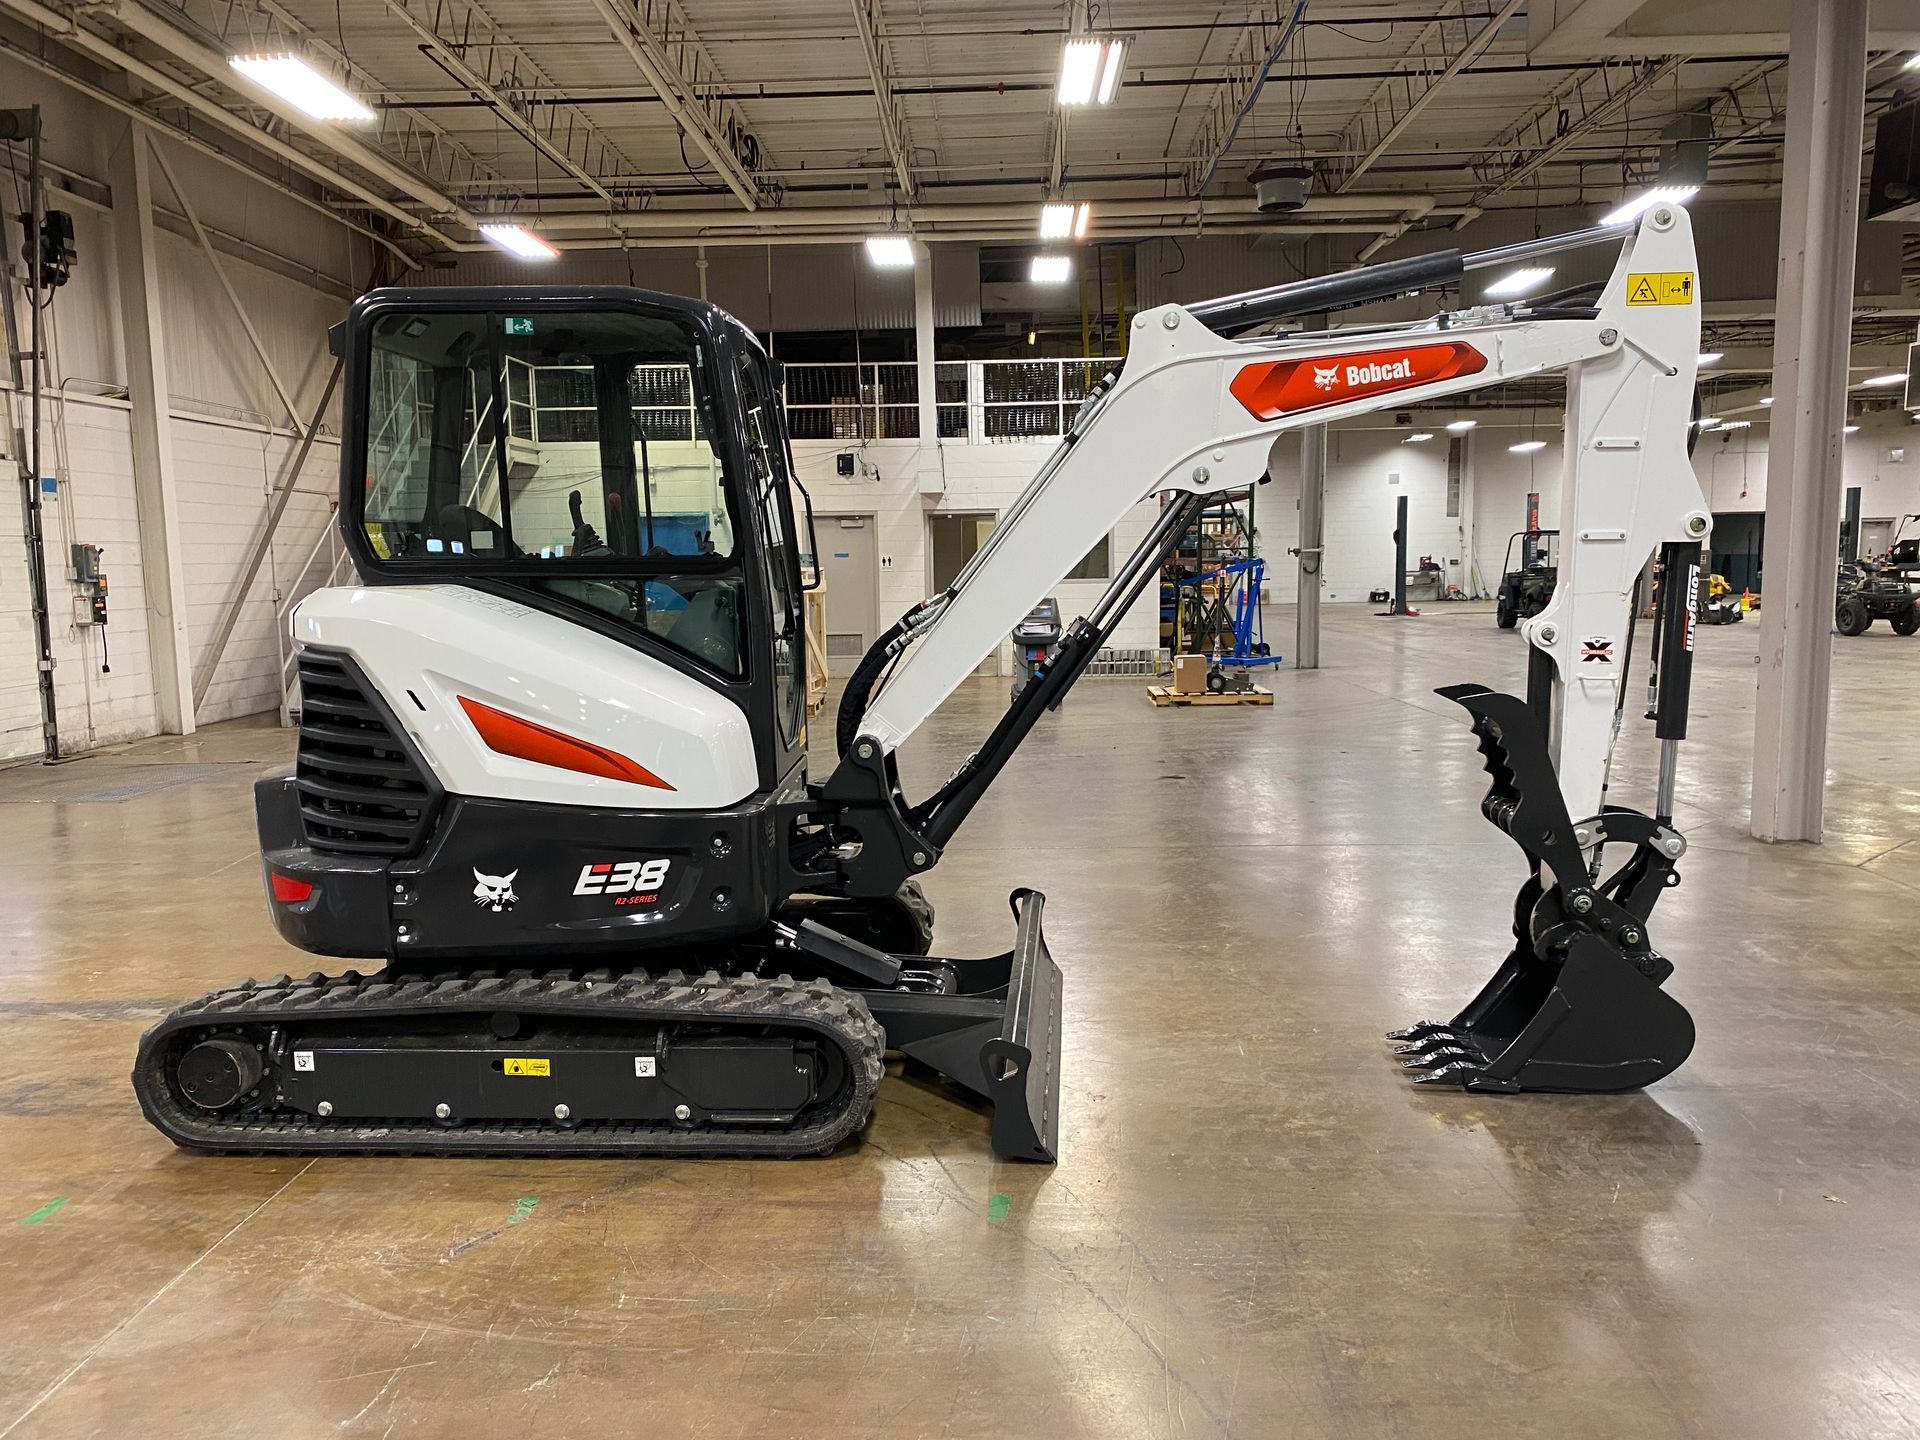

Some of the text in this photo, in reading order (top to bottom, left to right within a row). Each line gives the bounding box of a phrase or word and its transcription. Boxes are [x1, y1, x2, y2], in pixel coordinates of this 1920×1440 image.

[1346, 358, 1411, 386] Bobcat
[1686, 564, 1700, 652] LongArm
[573, 859, 671, 895] E38
[614, 894, 658, 906] R2-SERIES
